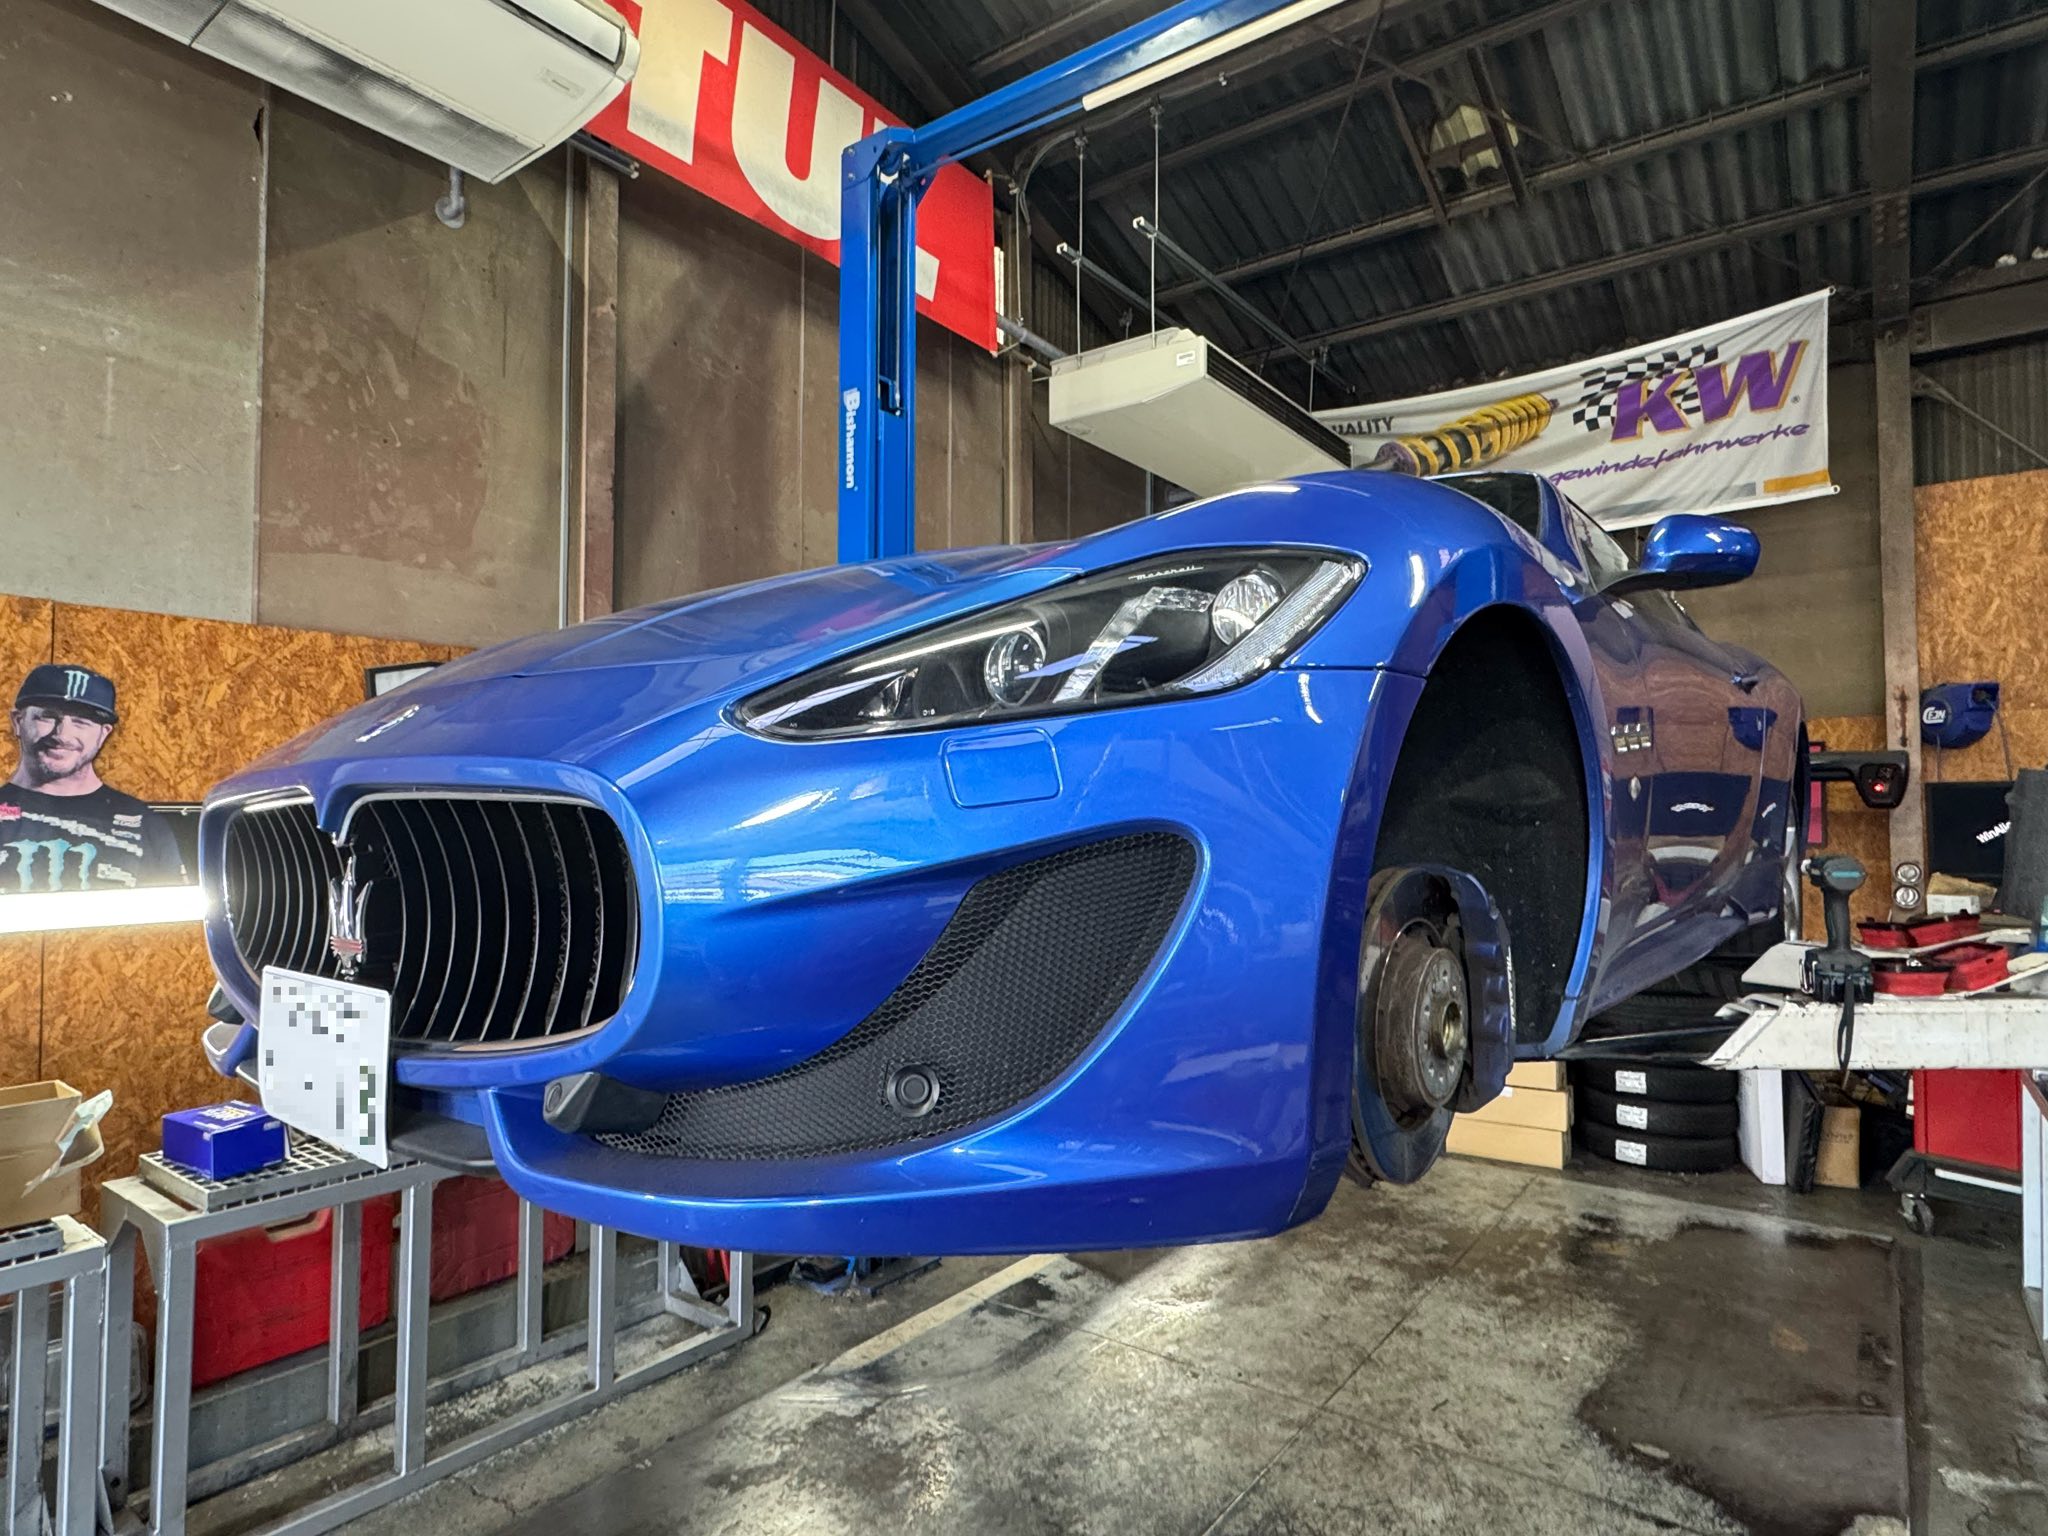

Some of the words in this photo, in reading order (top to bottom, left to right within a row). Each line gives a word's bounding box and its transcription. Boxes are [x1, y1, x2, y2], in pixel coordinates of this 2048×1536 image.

[626, 0, 940, 302] TU
[843, 388, 859, 488] Bishamon
[1611, 339, 1809, 443] KW
